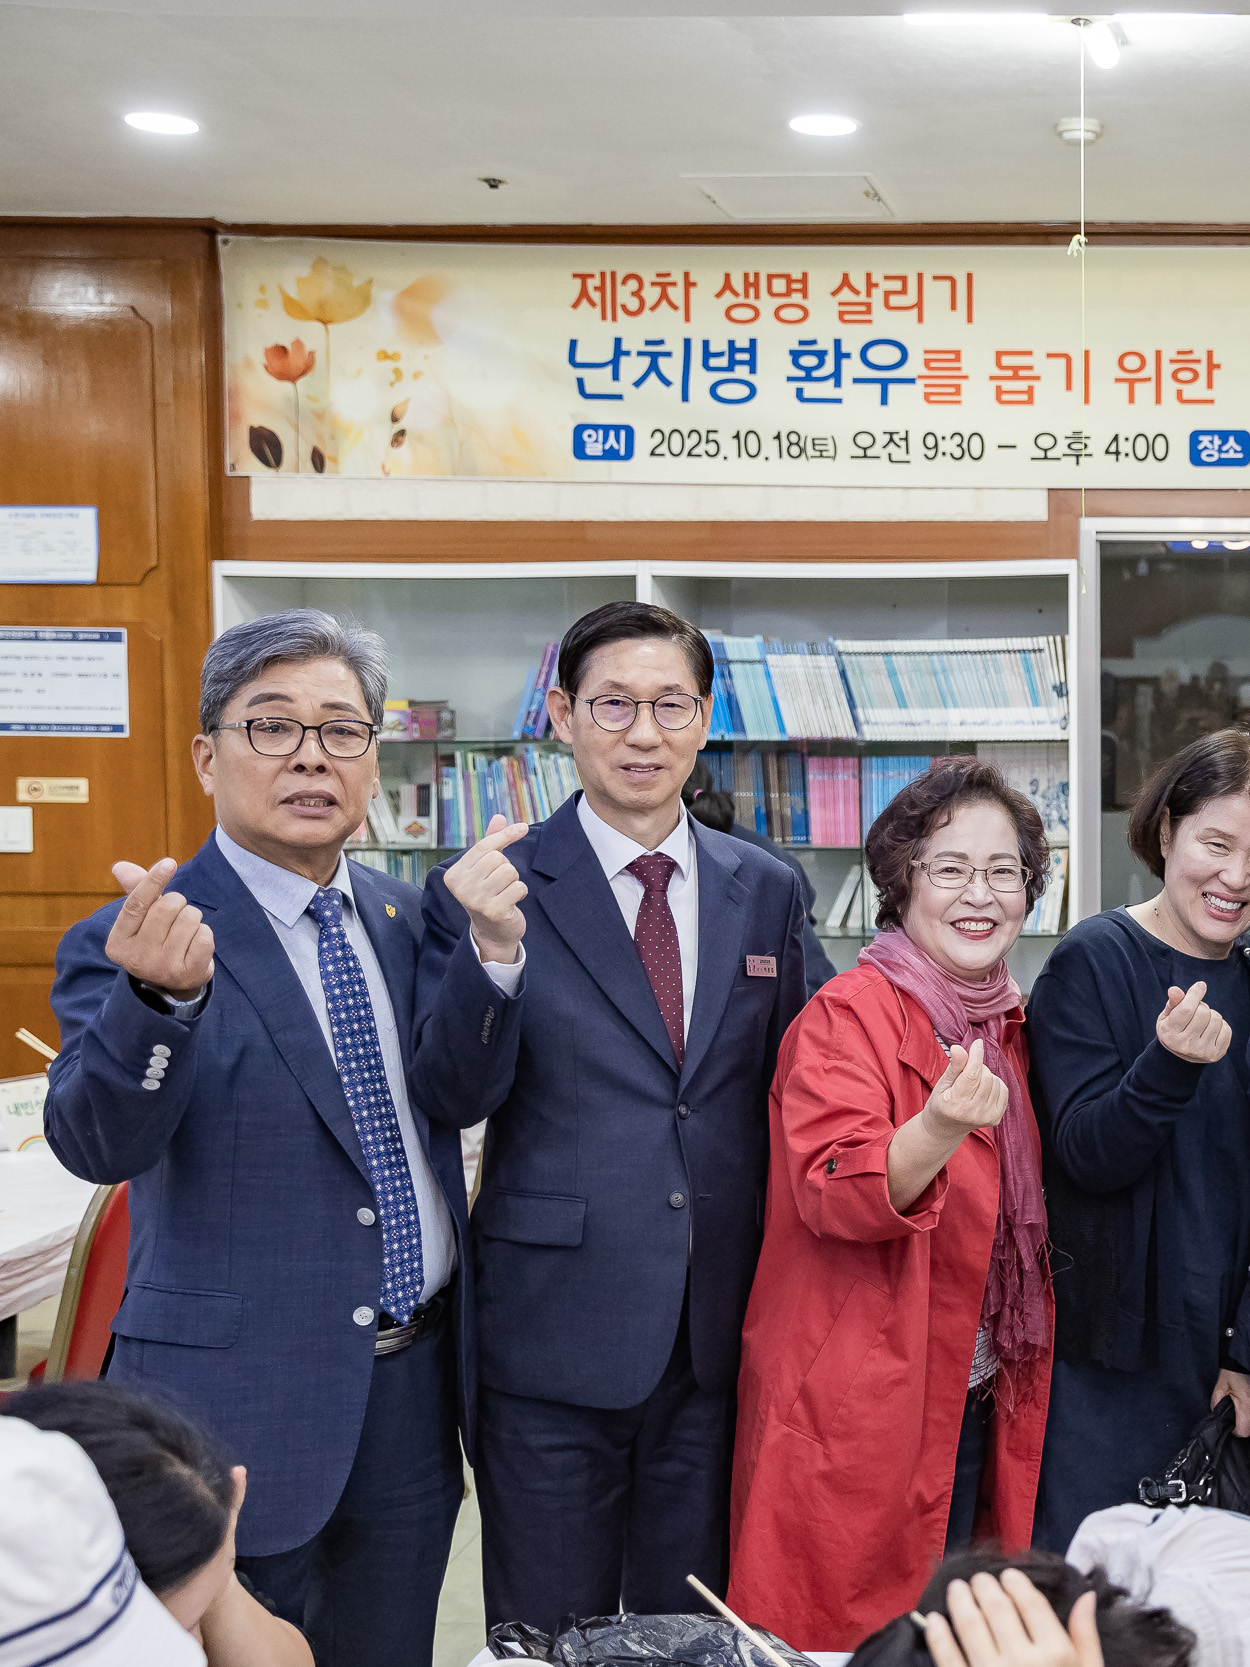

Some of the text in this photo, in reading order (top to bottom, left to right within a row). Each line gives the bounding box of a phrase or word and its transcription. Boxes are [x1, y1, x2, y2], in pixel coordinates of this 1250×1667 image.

[571, 271, 974, 325] 제3차 생명 살리기
[568, 336, 1222, 406] 난치병 환우를 돕기 위한
[581, 427, 627, 458] 일시
[649, 428, 837, 463] 2025.10.18(토)
[850, 430, 911, 464] 오전
[921, 431, 985, 462] 9:30
[1030, 430, 1094, 467] 오후
[1104, 431, 1170, 463] 4:00
[1196, 432, 1245, 464] 장소
